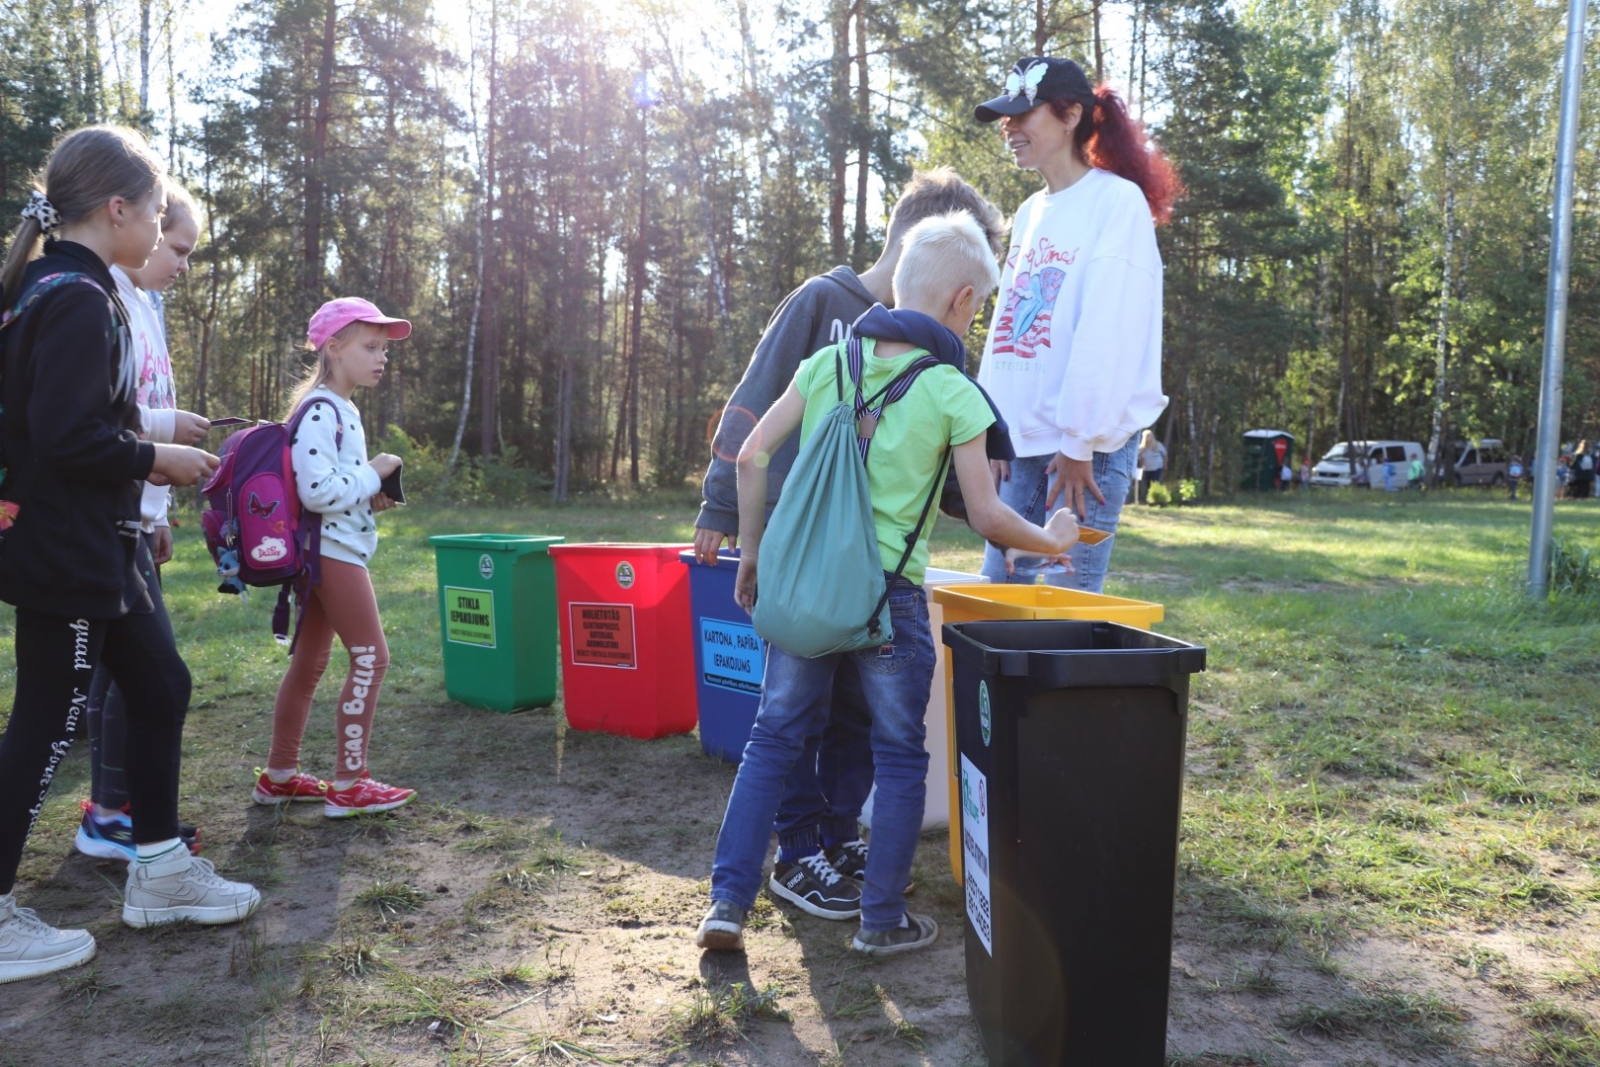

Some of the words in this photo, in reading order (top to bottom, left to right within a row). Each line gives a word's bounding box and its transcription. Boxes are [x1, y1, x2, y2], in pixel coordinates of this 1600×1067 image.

[458, 596, 480, 611] STIKLA
[450, 610, 490, 627] IEPAKOJUMS
[737, 633, 760, 652] PAPĪRA
[713, 653, 751, 673] IEPAKOJUMS
[66, 687, 88, 732] New
